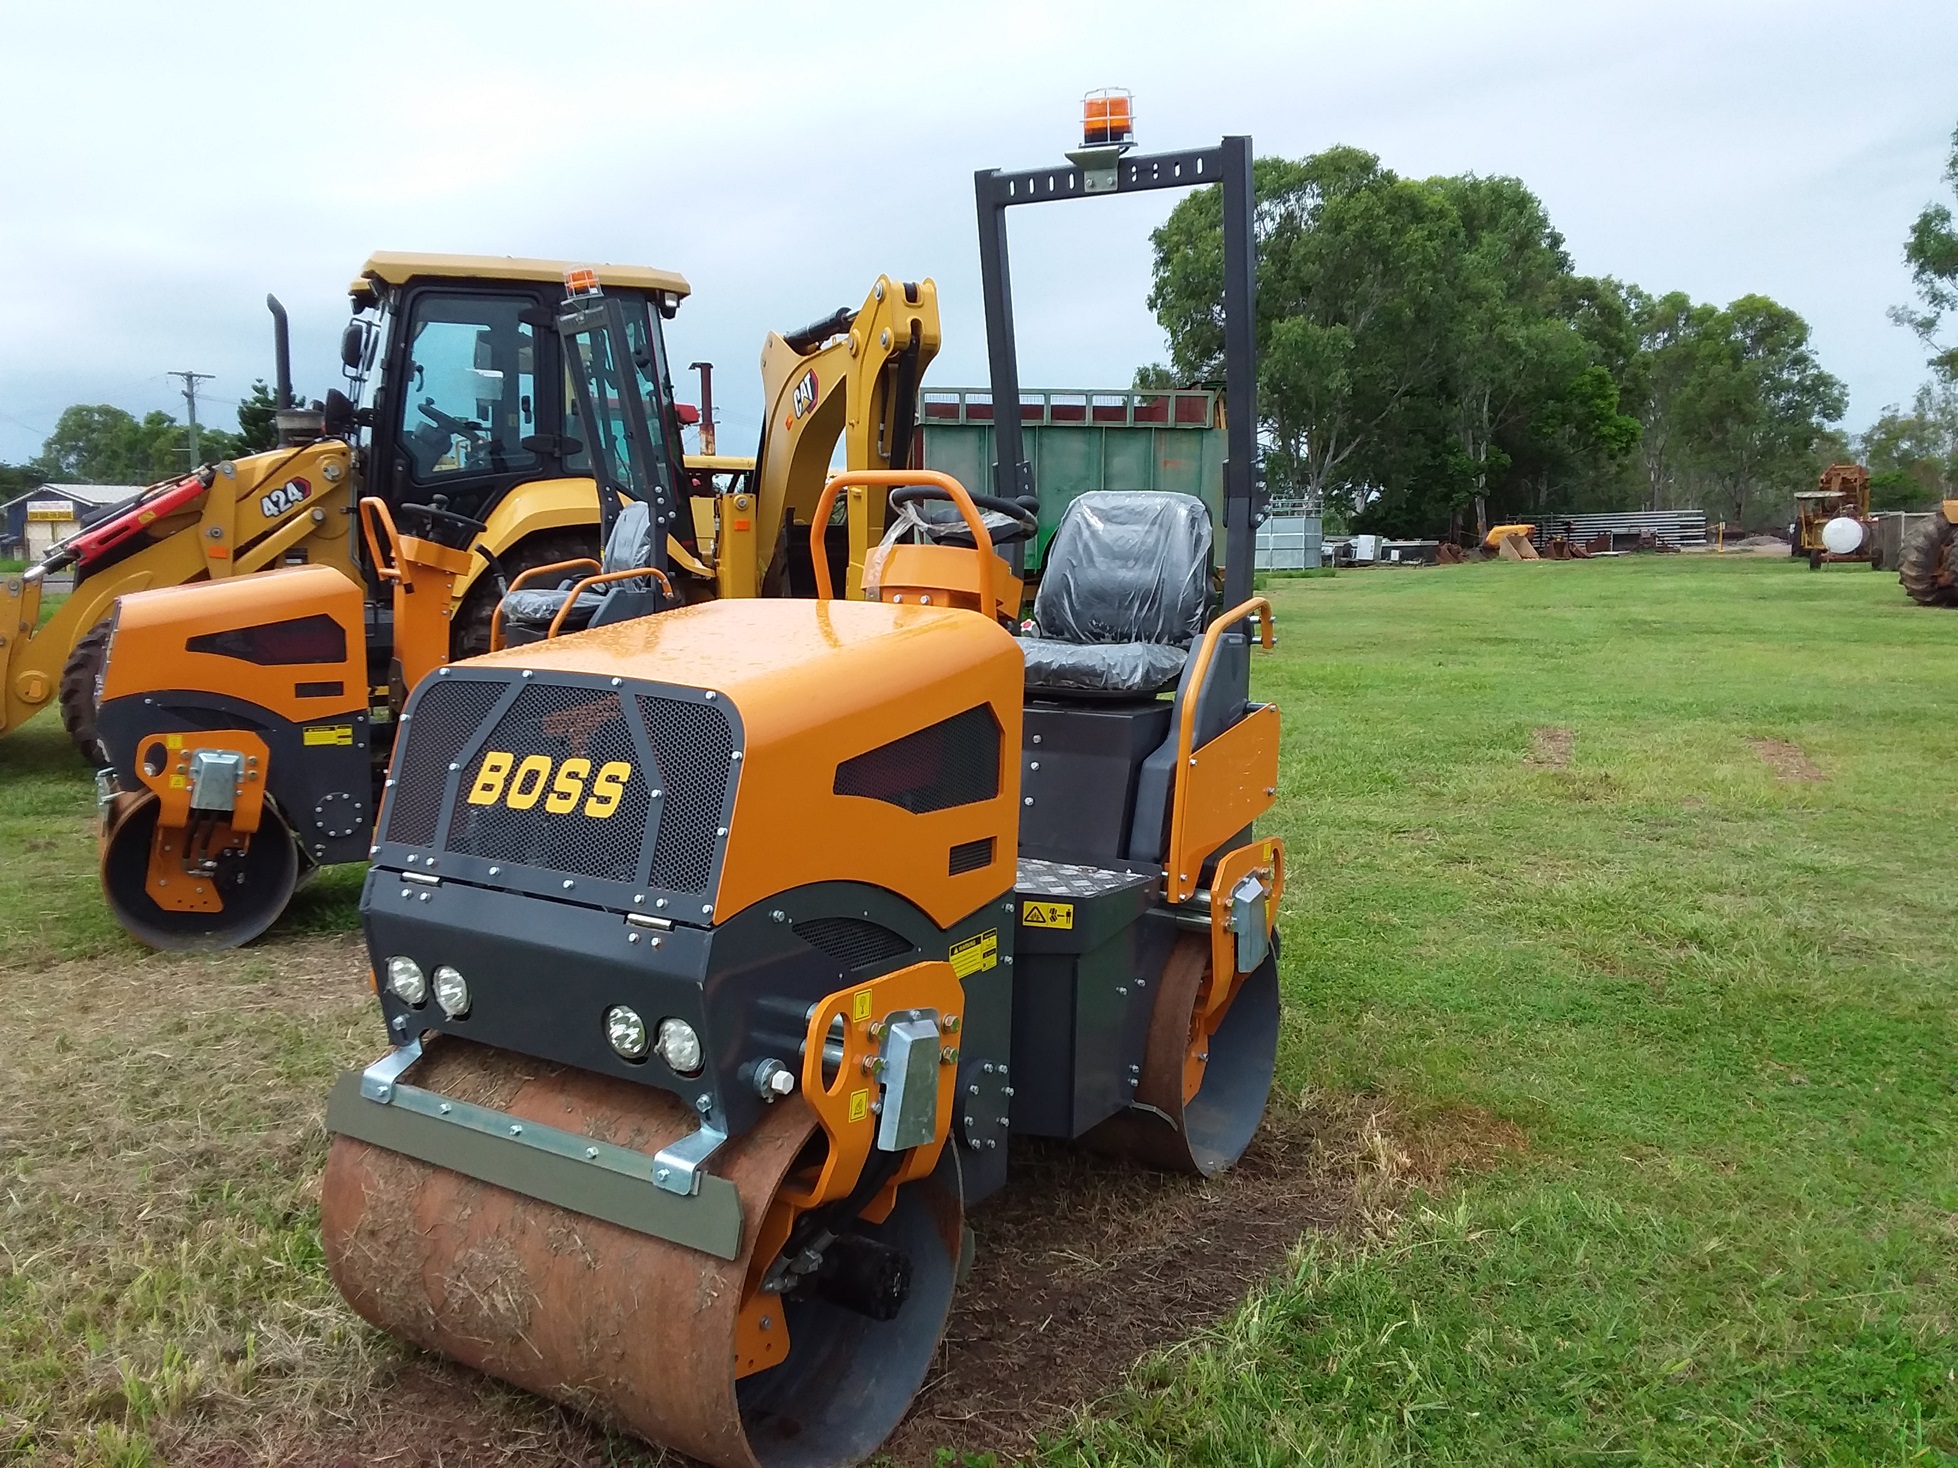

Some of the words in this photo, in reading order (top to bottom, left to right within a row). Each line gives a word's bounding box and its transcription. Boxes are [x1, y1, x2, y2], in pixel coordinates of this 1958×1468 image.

[793, 371, 814, 419] CAT
[261, 481, 304, 517] 424
[467, 751, 632, 818] BOSS
